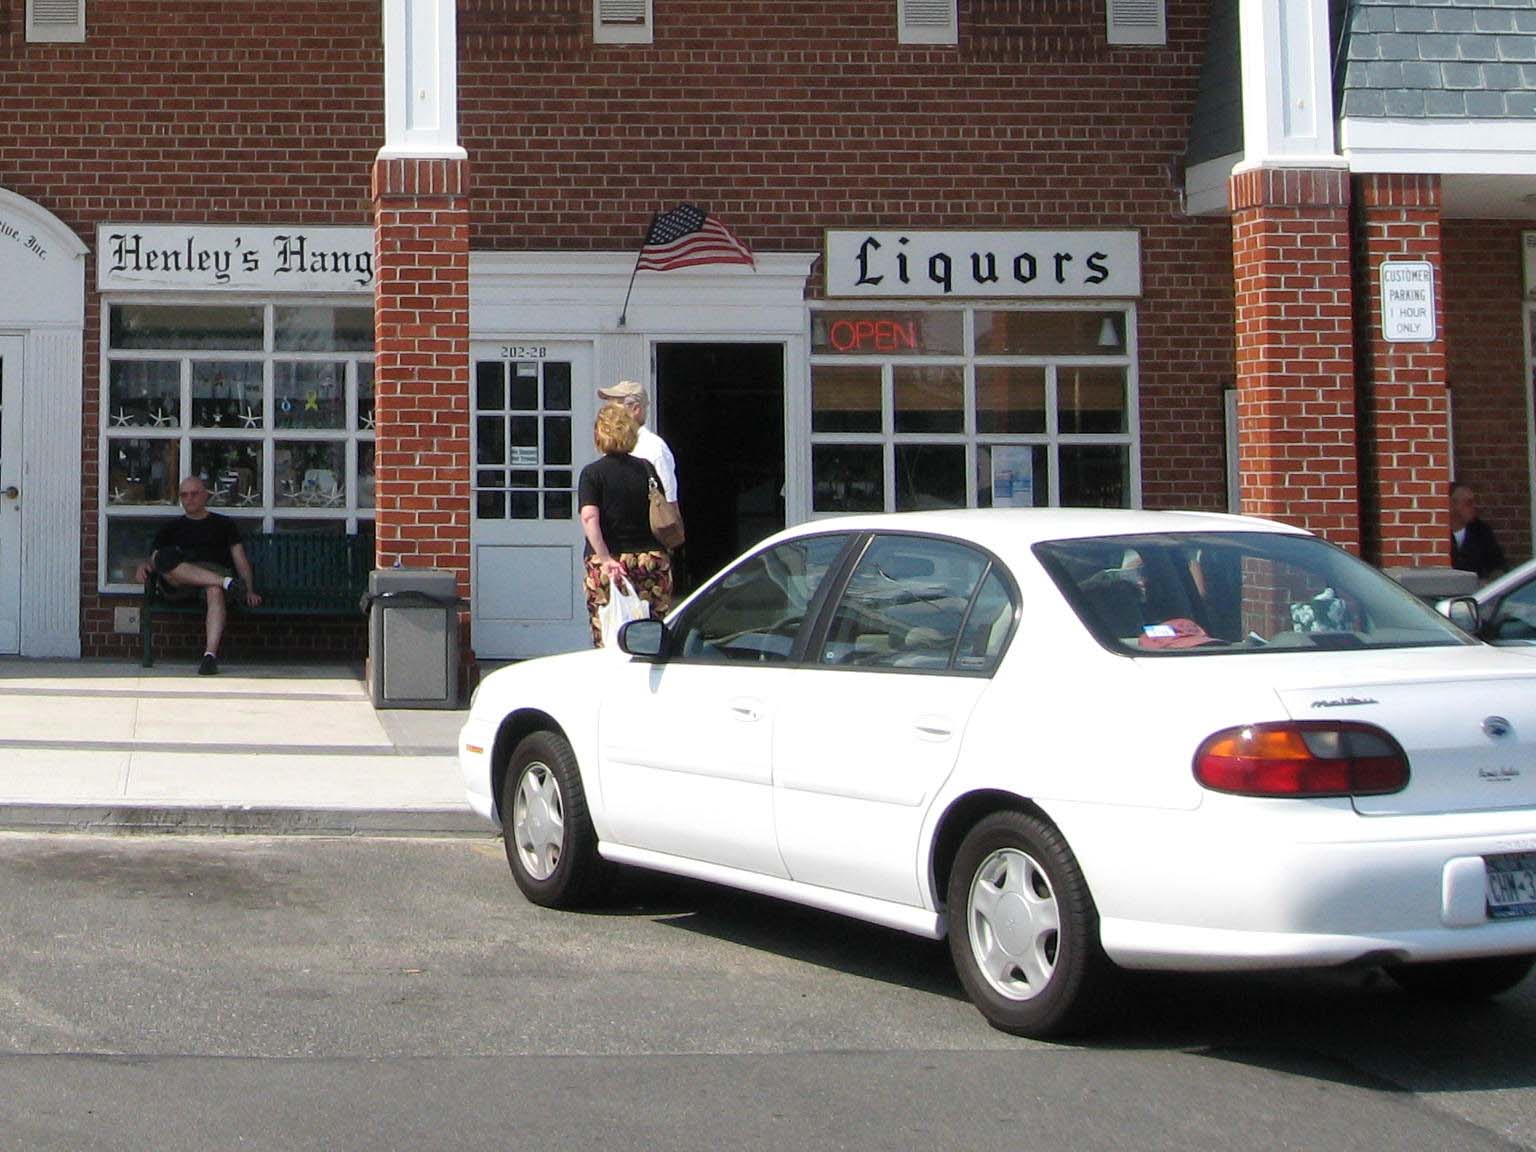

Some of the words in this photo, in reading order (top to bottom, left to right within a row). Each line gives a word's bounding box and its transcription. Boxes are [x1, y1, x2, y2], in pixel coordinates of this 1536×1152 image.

[24, 234, 48, 261] Inc.
[108, 234, 259, 284] Henley's
[273, 235, 374, 286] Hang
[855, 236, 1110, 293] Liquors
[1384, 270, 1432, 282] CUSTOMER
[1389, 289, 1426, 301] PARKING
[1399, 307, 1427, 318] HOUR
[831, 320, 914, 350] OPEN
[1396, 323, 1421, 334] ONLY
[501, 346, 547, 359] 202-28
